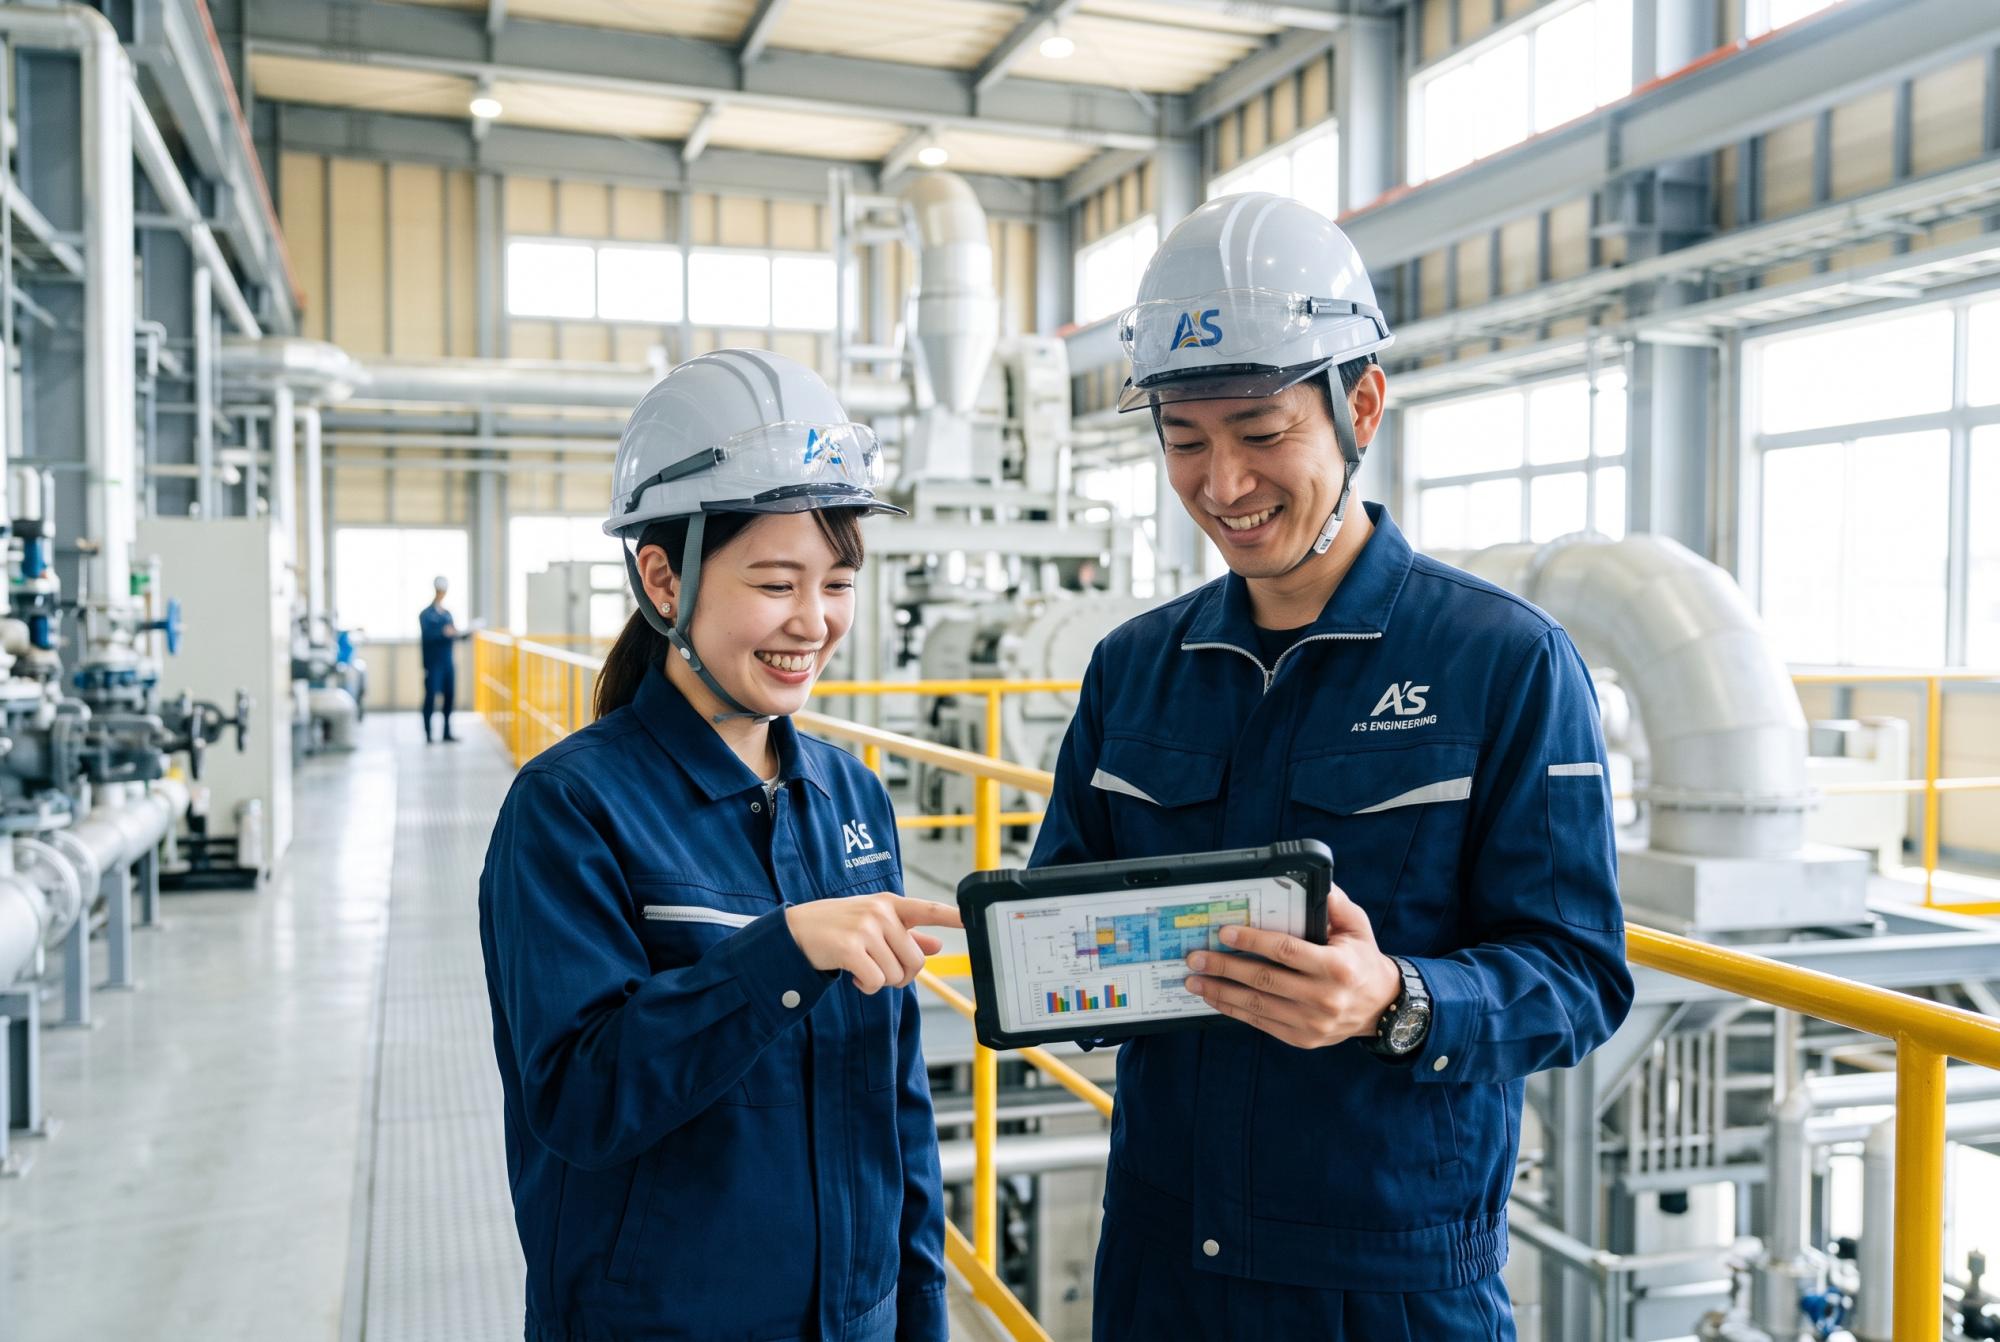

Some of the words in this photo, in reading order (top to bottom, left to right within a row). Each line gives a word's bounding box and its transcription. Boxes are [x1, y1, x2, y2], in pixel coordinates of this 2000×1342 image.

[1369, 681, 1431, 717] A'S
[1369, 714, 1438, 732] ENGINEERING
[842, 819, 874, 854] A'S
